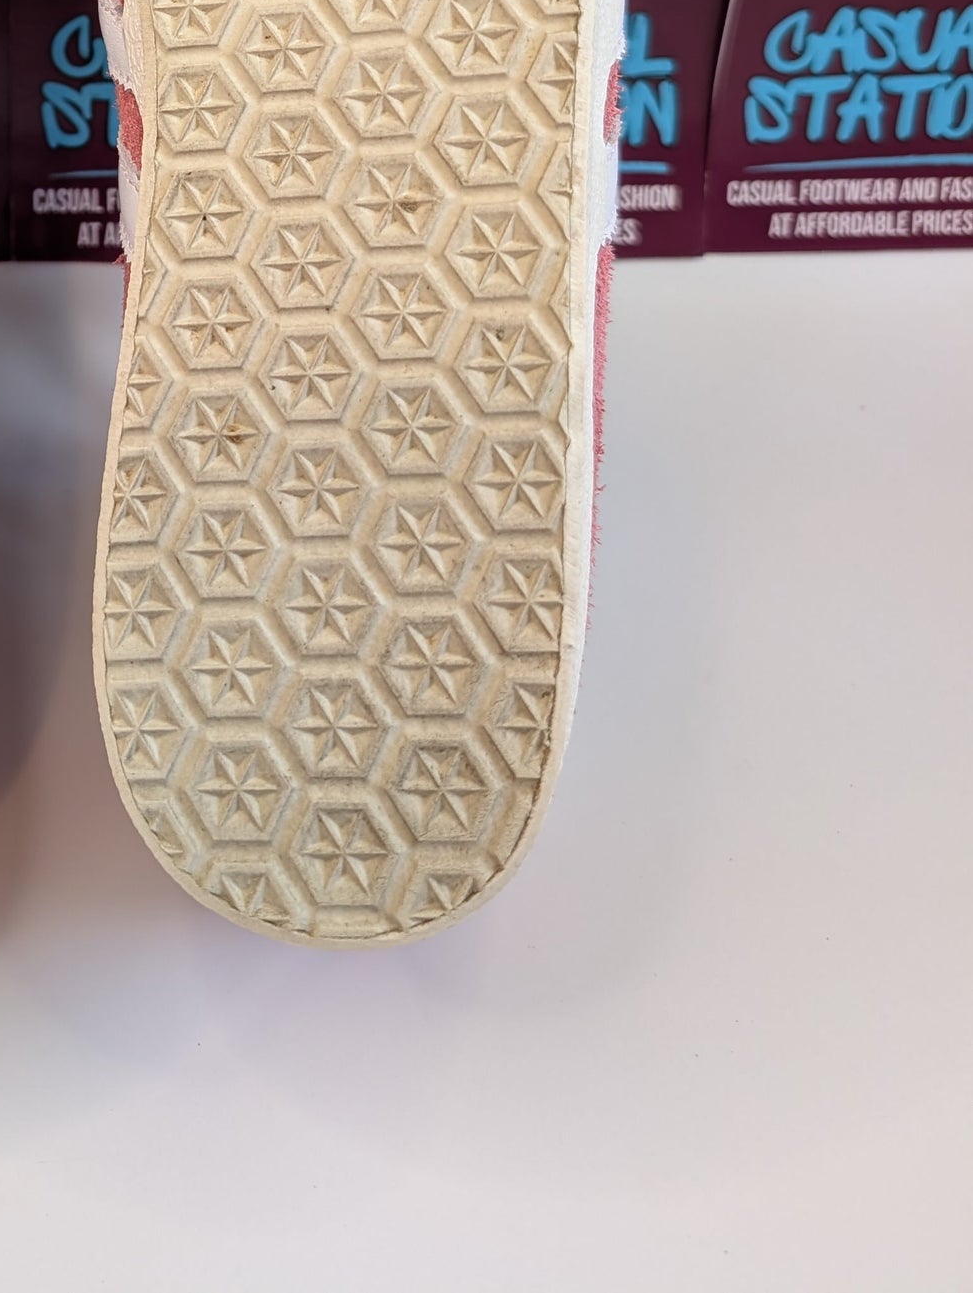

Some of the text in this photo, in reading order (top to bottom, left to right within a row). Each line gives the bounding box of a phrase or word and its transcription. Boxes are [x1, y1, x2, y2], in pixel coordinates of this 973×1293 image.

[33, 188, 105, 214] CASUAL
[727, 180, 797, 207] CASUAL
[799, 178, 900, 205] FOOTWEAR
[899, 177, 939, 203] AND
[77, 221, 101, 247] AT
[768, 213, 795, 239] AT
[794, 211, 911, 238] AFFORDABLE
